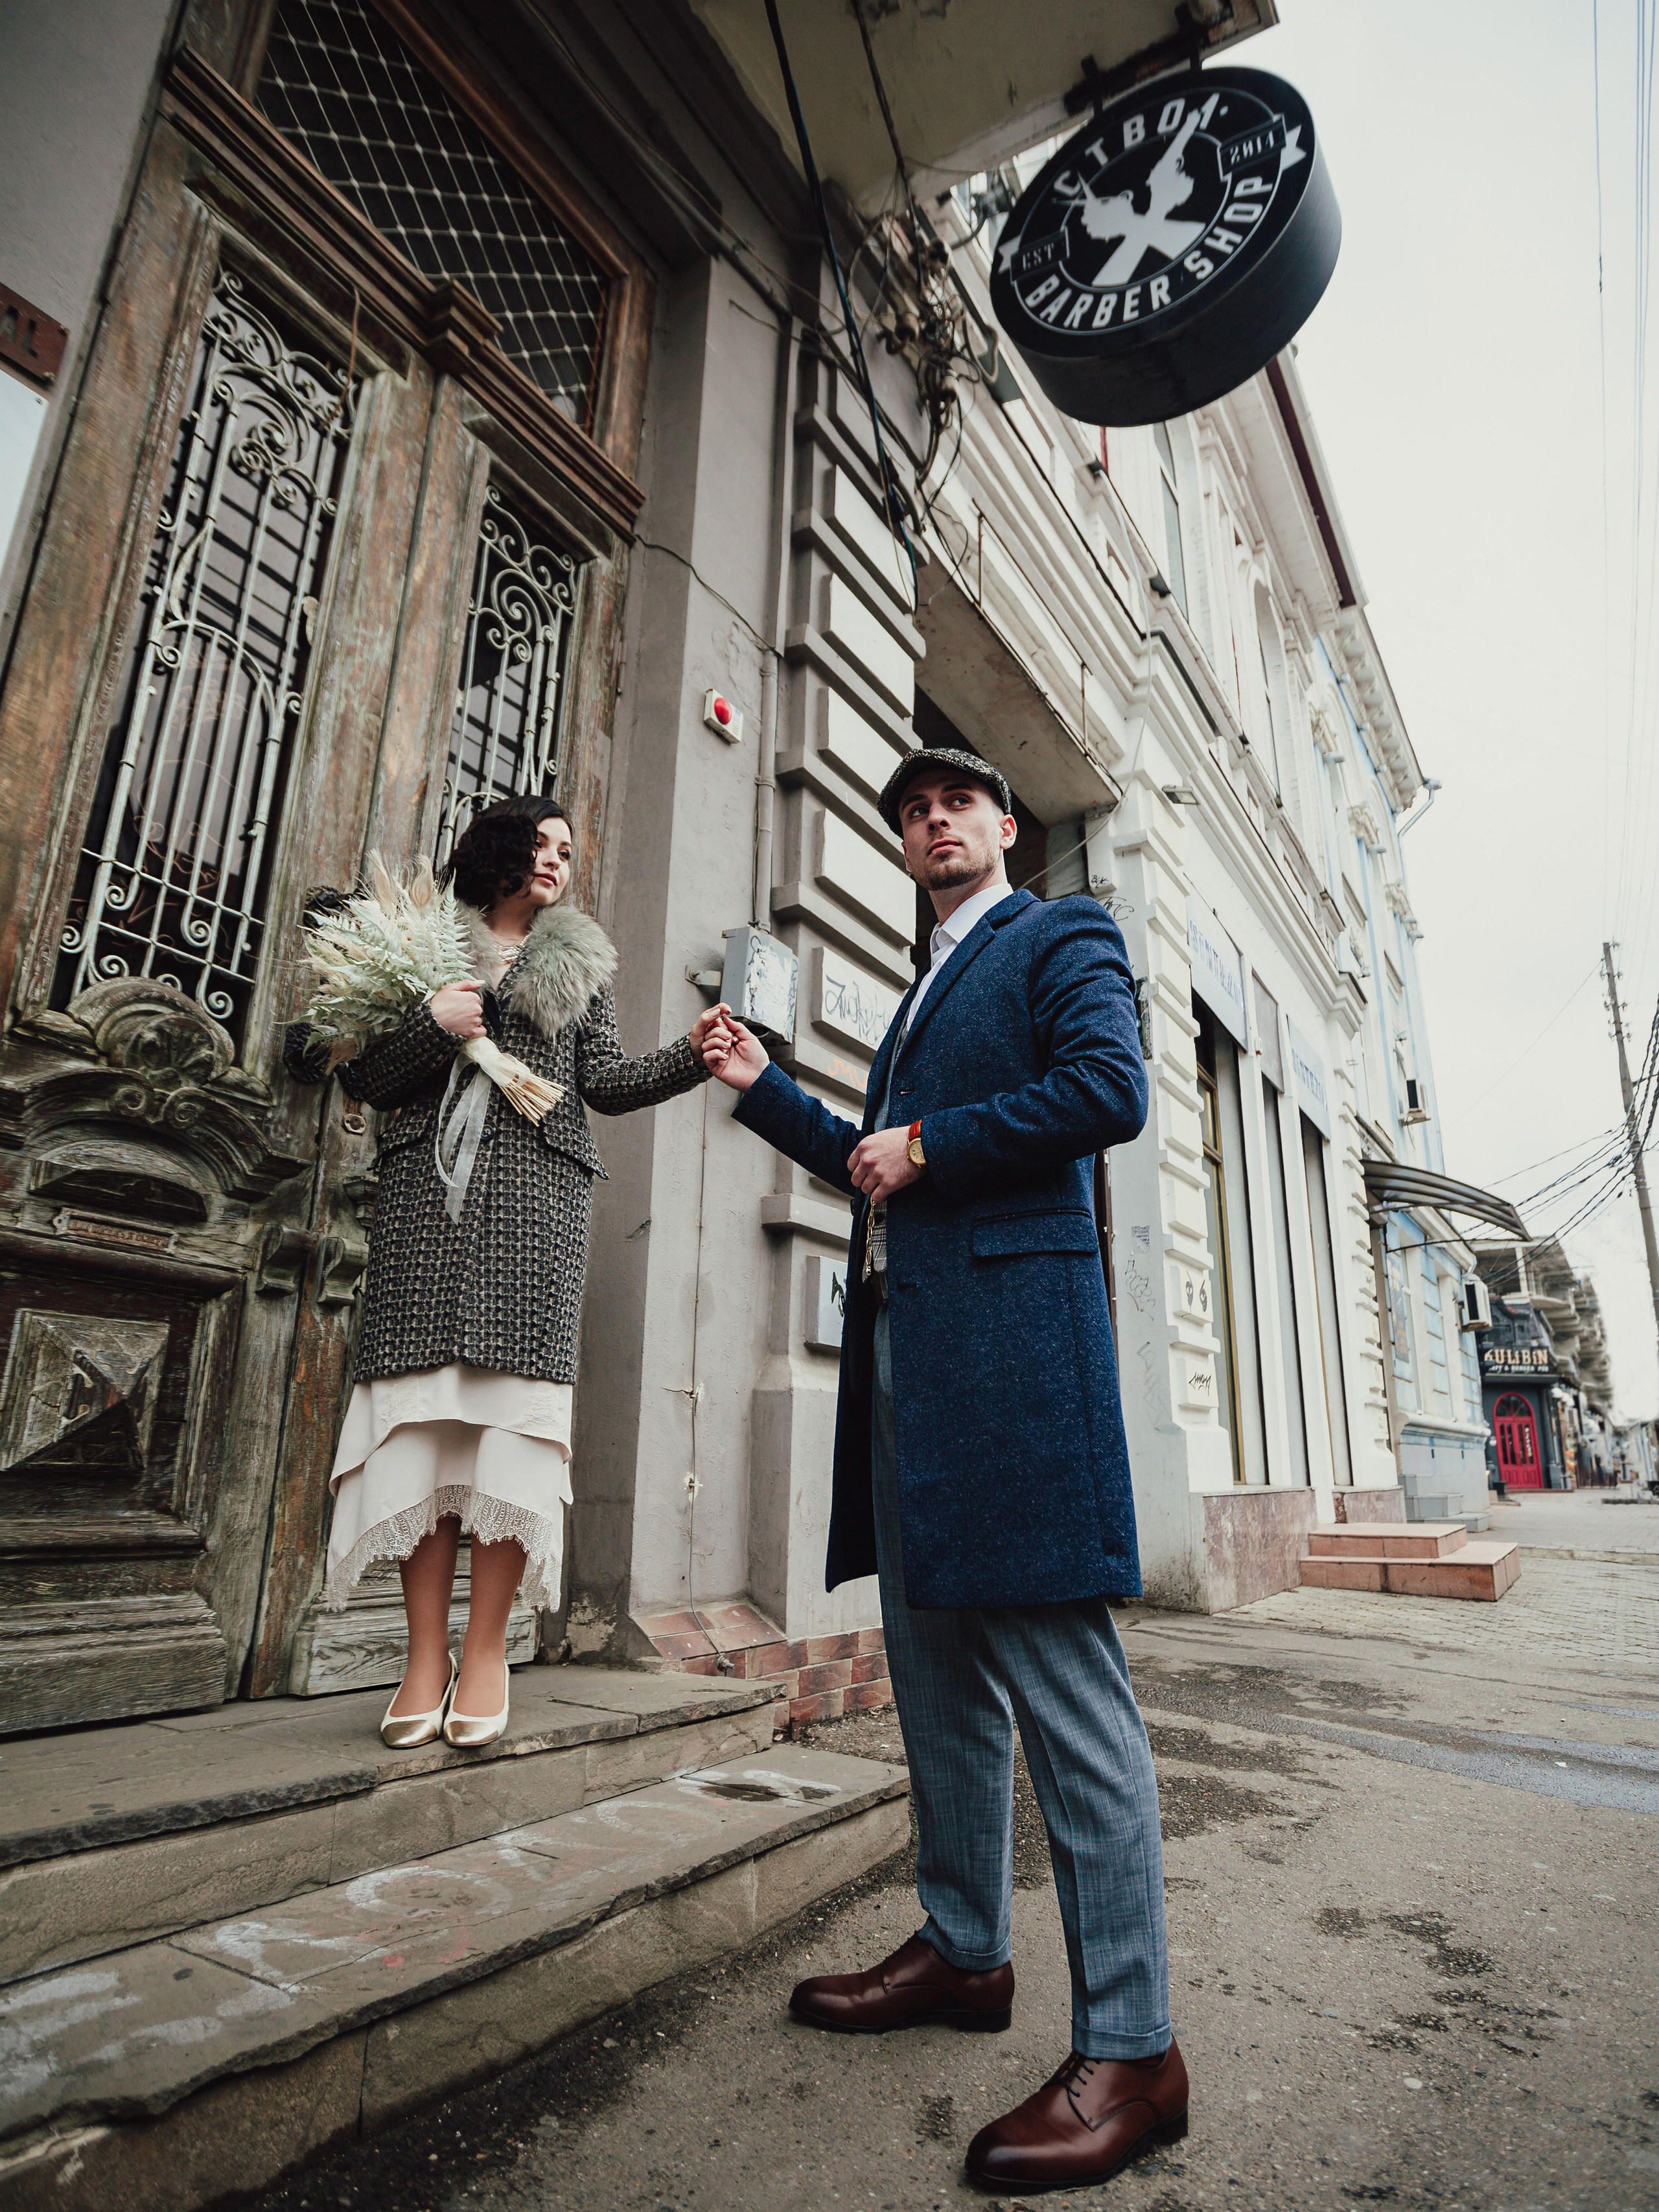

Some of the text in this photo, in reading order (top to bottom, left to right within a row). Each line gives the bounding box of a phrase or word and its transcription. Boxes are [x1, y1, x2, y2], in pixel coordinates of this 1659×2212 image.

[1022, 242, 1055, 271] EST
[1025, 176, 1273, 329] BARBER SHOP
